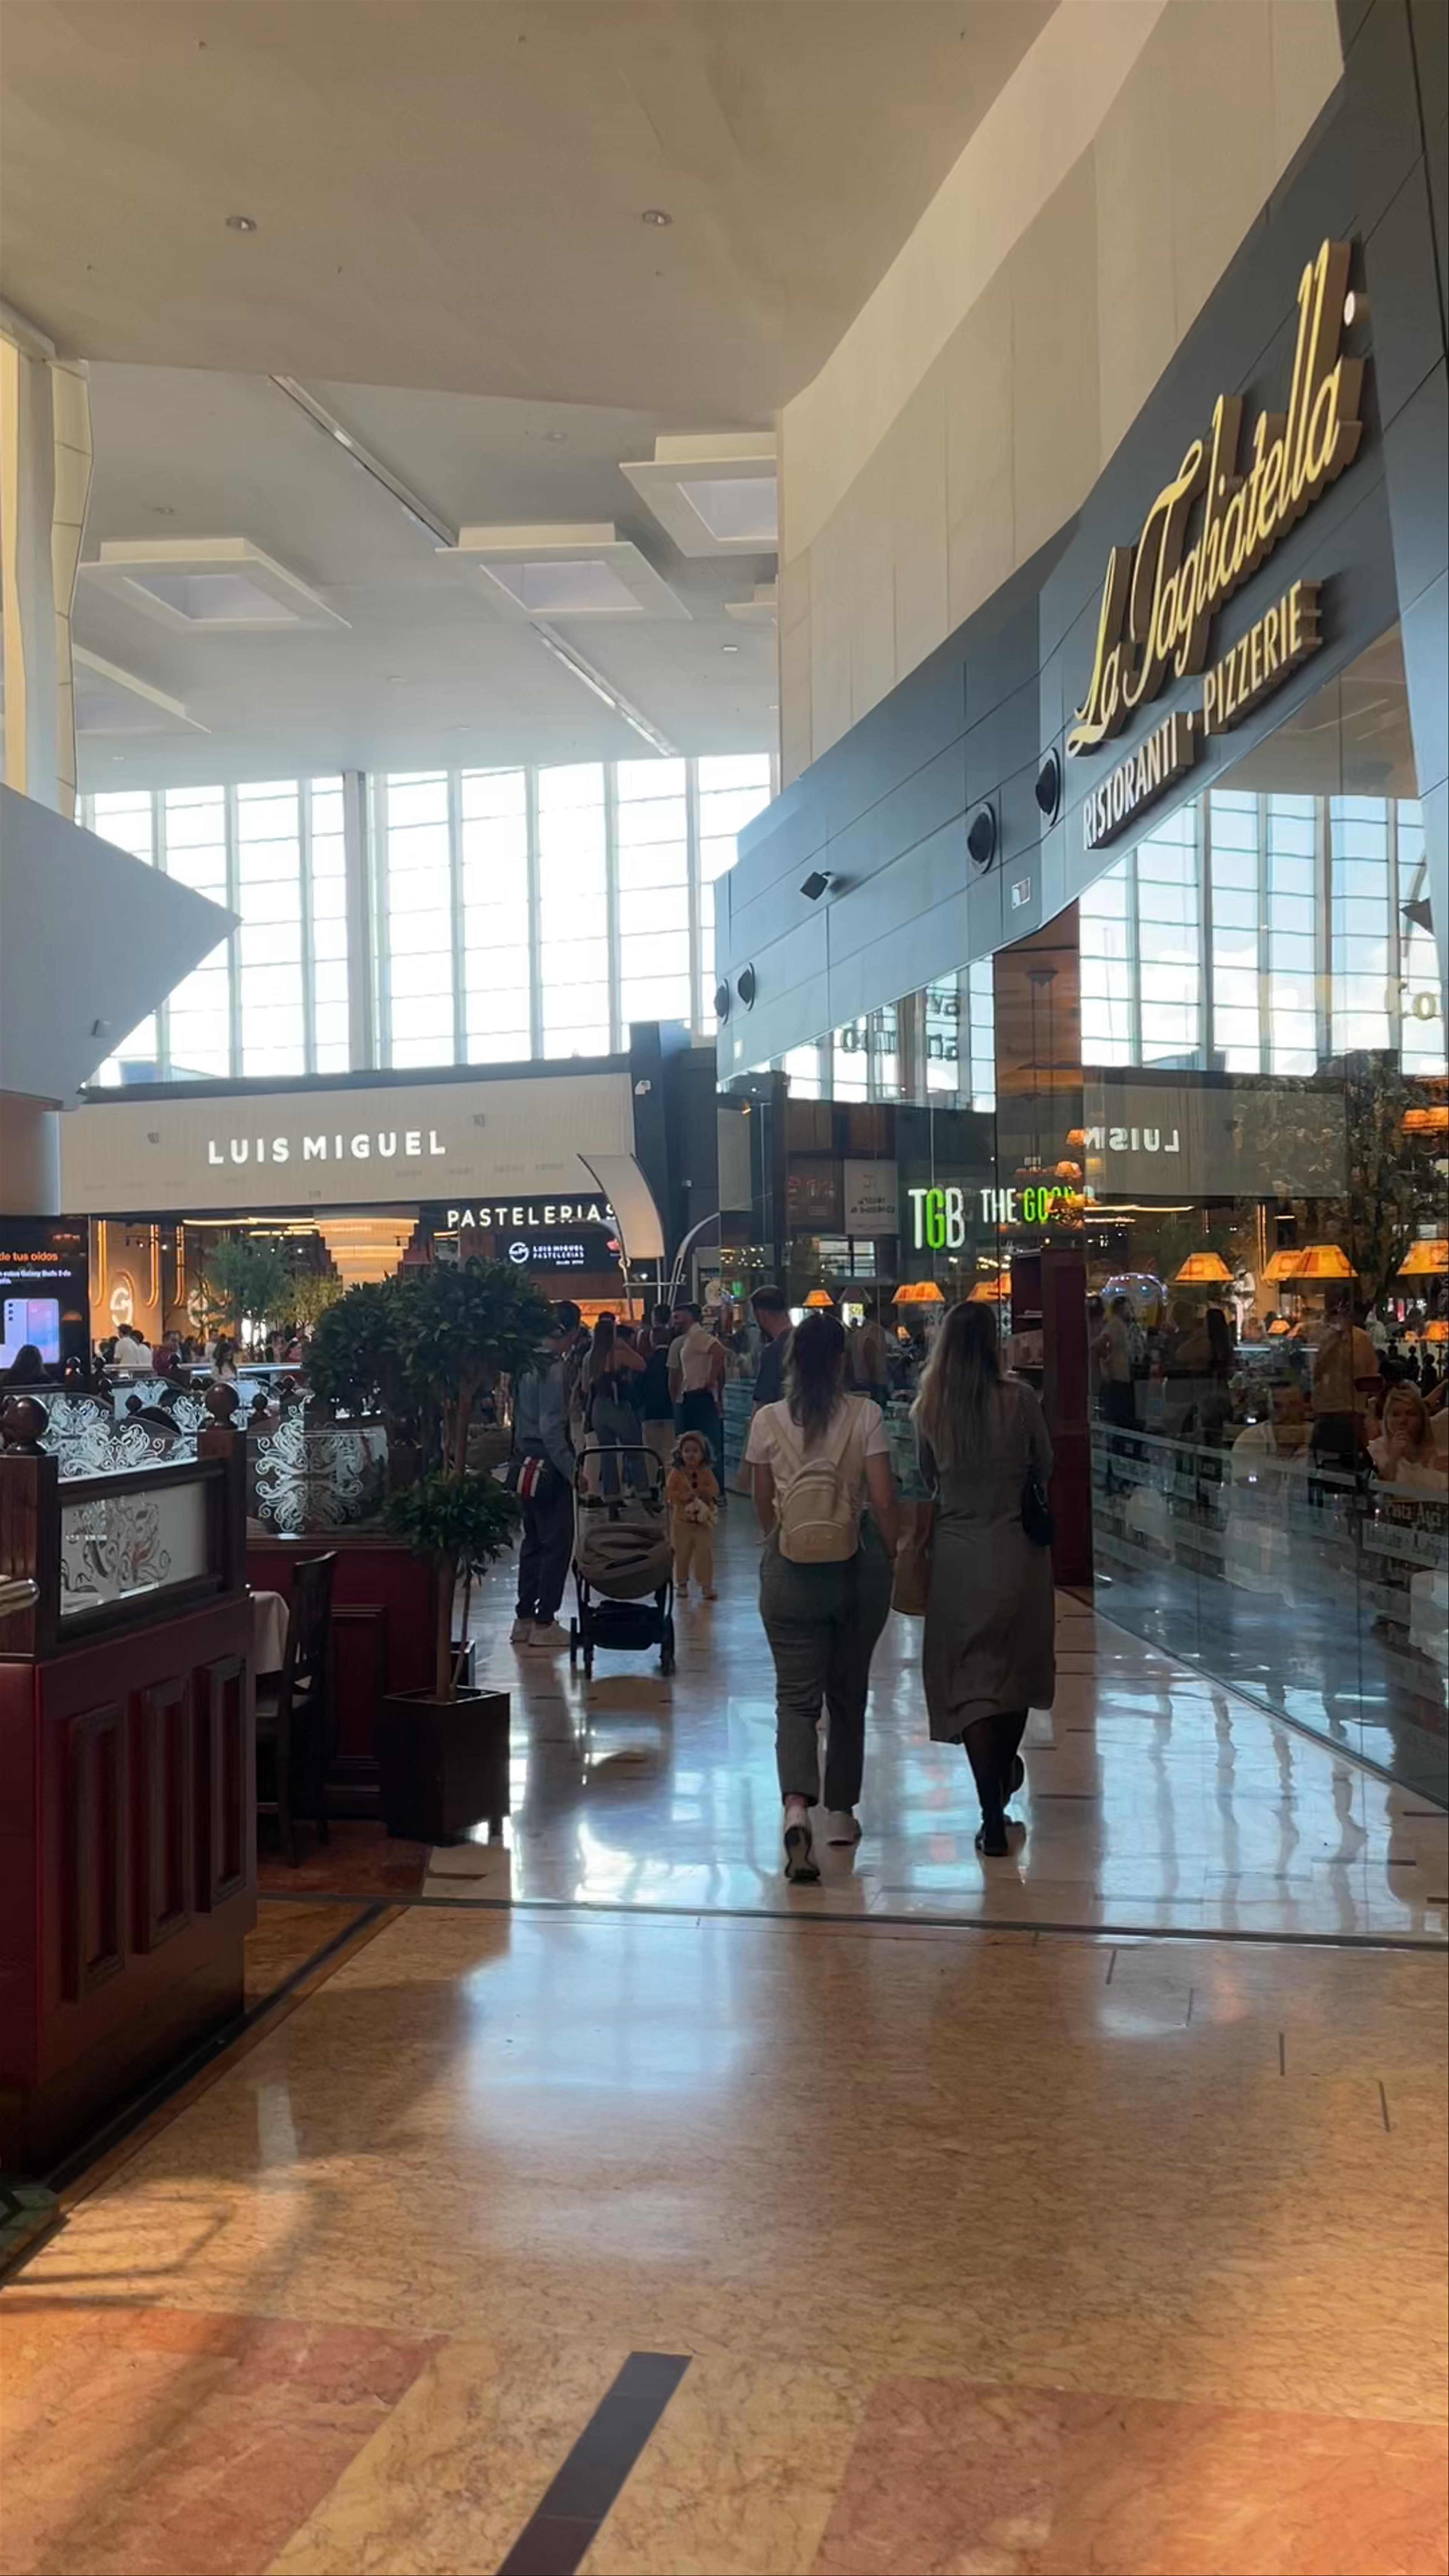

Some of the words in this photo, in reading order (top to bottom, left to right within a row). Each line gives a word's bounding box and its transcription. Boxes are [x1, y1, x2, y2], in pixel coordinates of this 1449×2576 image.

[1067, 546, 1121, 757] La
[1123, 238, 1343, 706] Tagliatella
[1083, 711, 1178, 851] RISTORANTI
[1203, 579, 1302, 737] PIZZERIE
[208, 1137, 290, 1164] LUIS
[303, 1130, 446, 1161] MIGUEL
[447, 1204, 616, 1228] PASTELERIAS
[908, 1187, 965, 1249] TGB
[980, 1188, 1018, 1223] THE
[13, 1252, 29, 1261] tus
